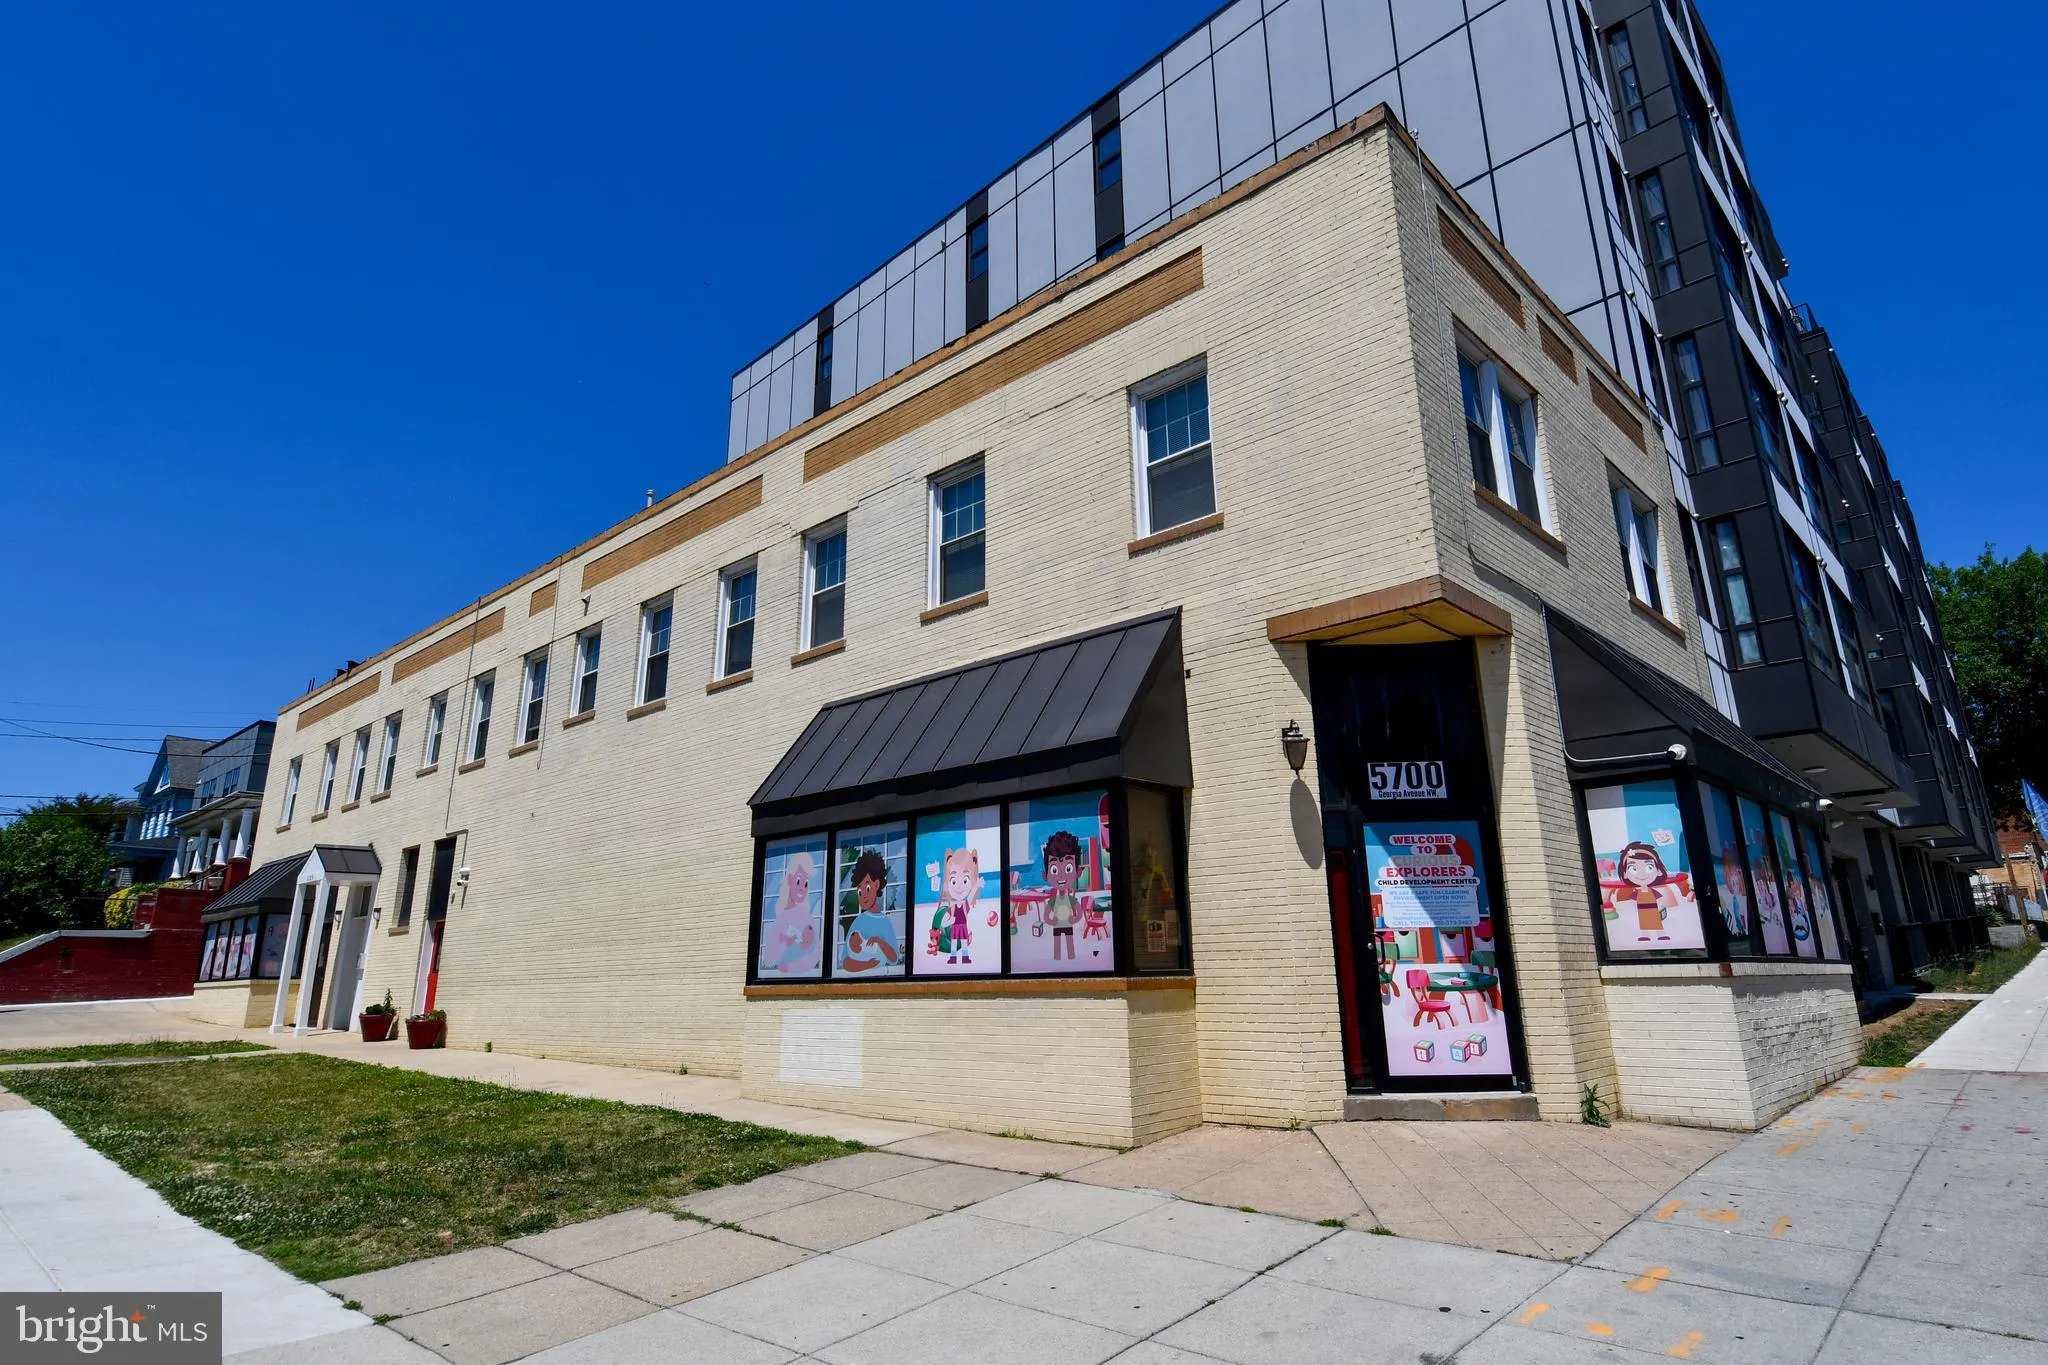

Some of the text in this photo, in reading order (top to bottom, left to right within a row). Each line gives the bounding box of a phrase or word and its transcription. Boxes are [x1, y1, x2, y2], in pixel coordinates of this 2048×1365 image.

[1370, 761, 1443, 789] 5700
[1378, 790, 1402, 800] Georgia
[1403, 789, 1425, 798] Avenue
[1392, 835, 1452, 844] WELCOME
[1417, 845, 1433, 854] TO
[1393, 855, 1458, 866] CURIOUS
[1386, 866, 1467, 878] EXPLORERS
